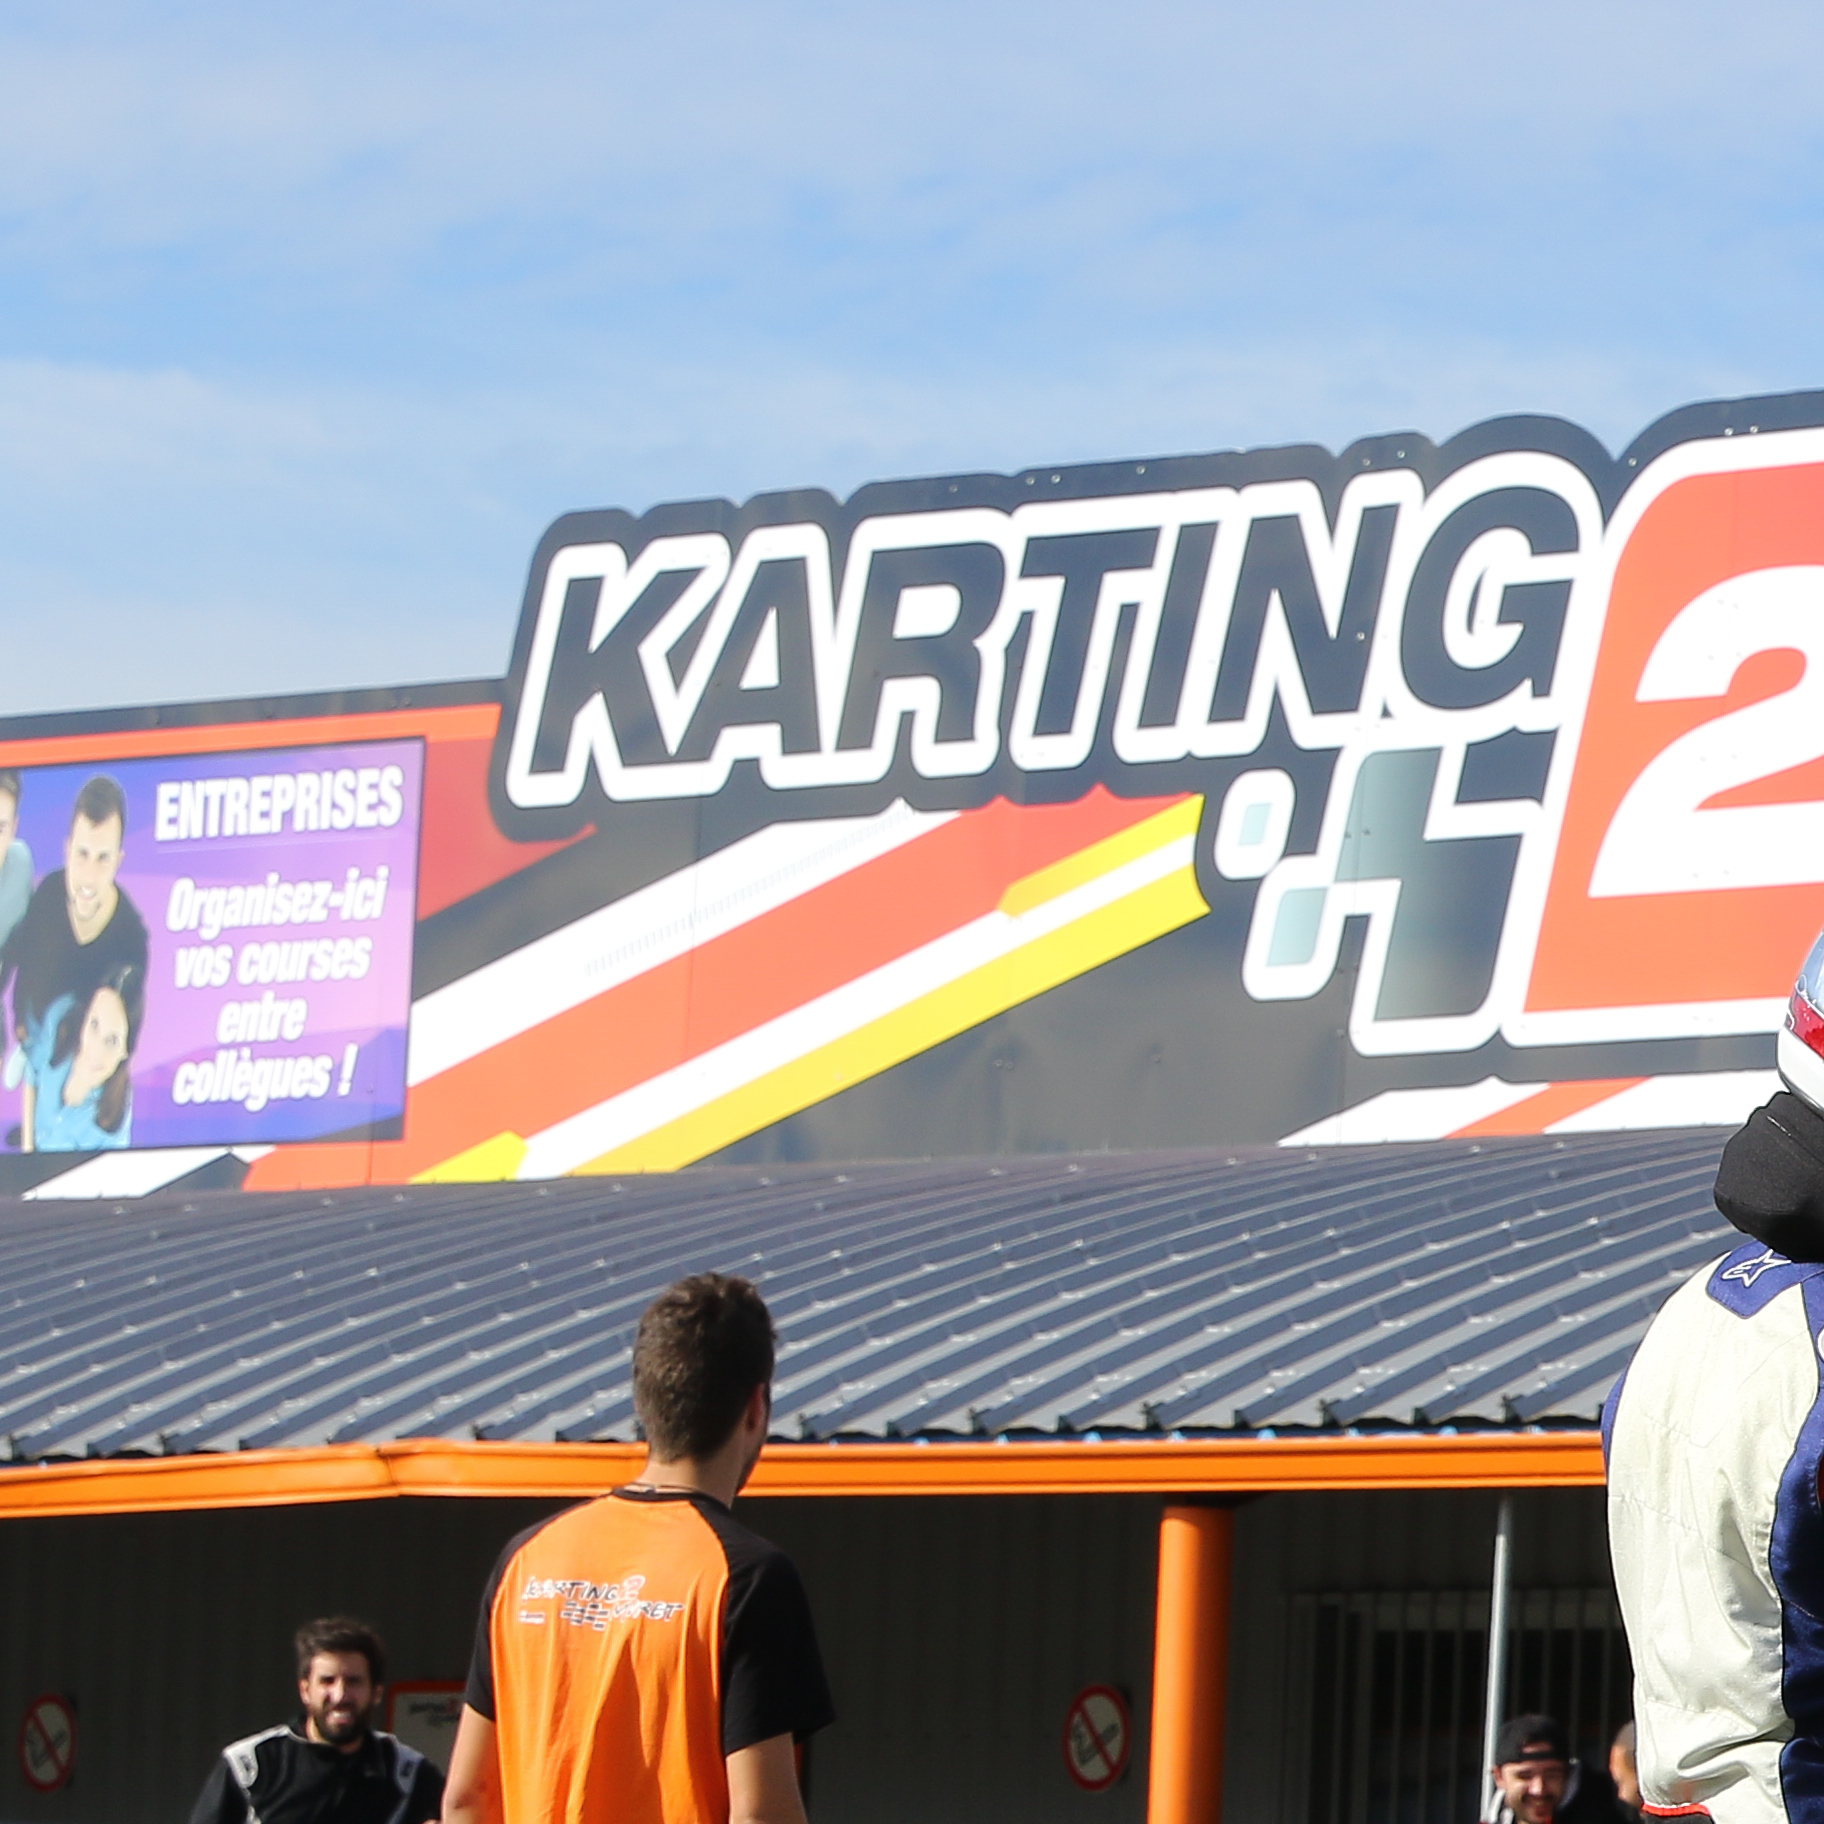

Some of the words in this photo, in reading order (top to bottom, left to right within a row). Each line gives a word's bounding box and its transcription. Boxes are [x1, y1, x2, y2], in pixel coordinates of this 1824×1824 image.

[526, 486, 1580, 774] KARTING
[154, 766, 403, 842] ENTREPRISES
[167, 866, 389, 937] Organisez-ici
[176, 948, 231, 989] vos
[238, 936, 370, 983] courses
[218, 991, 307, 1044] entre
[173, 1049, 331, 1112] collègues
[338, 1044, 359, 1097] !
